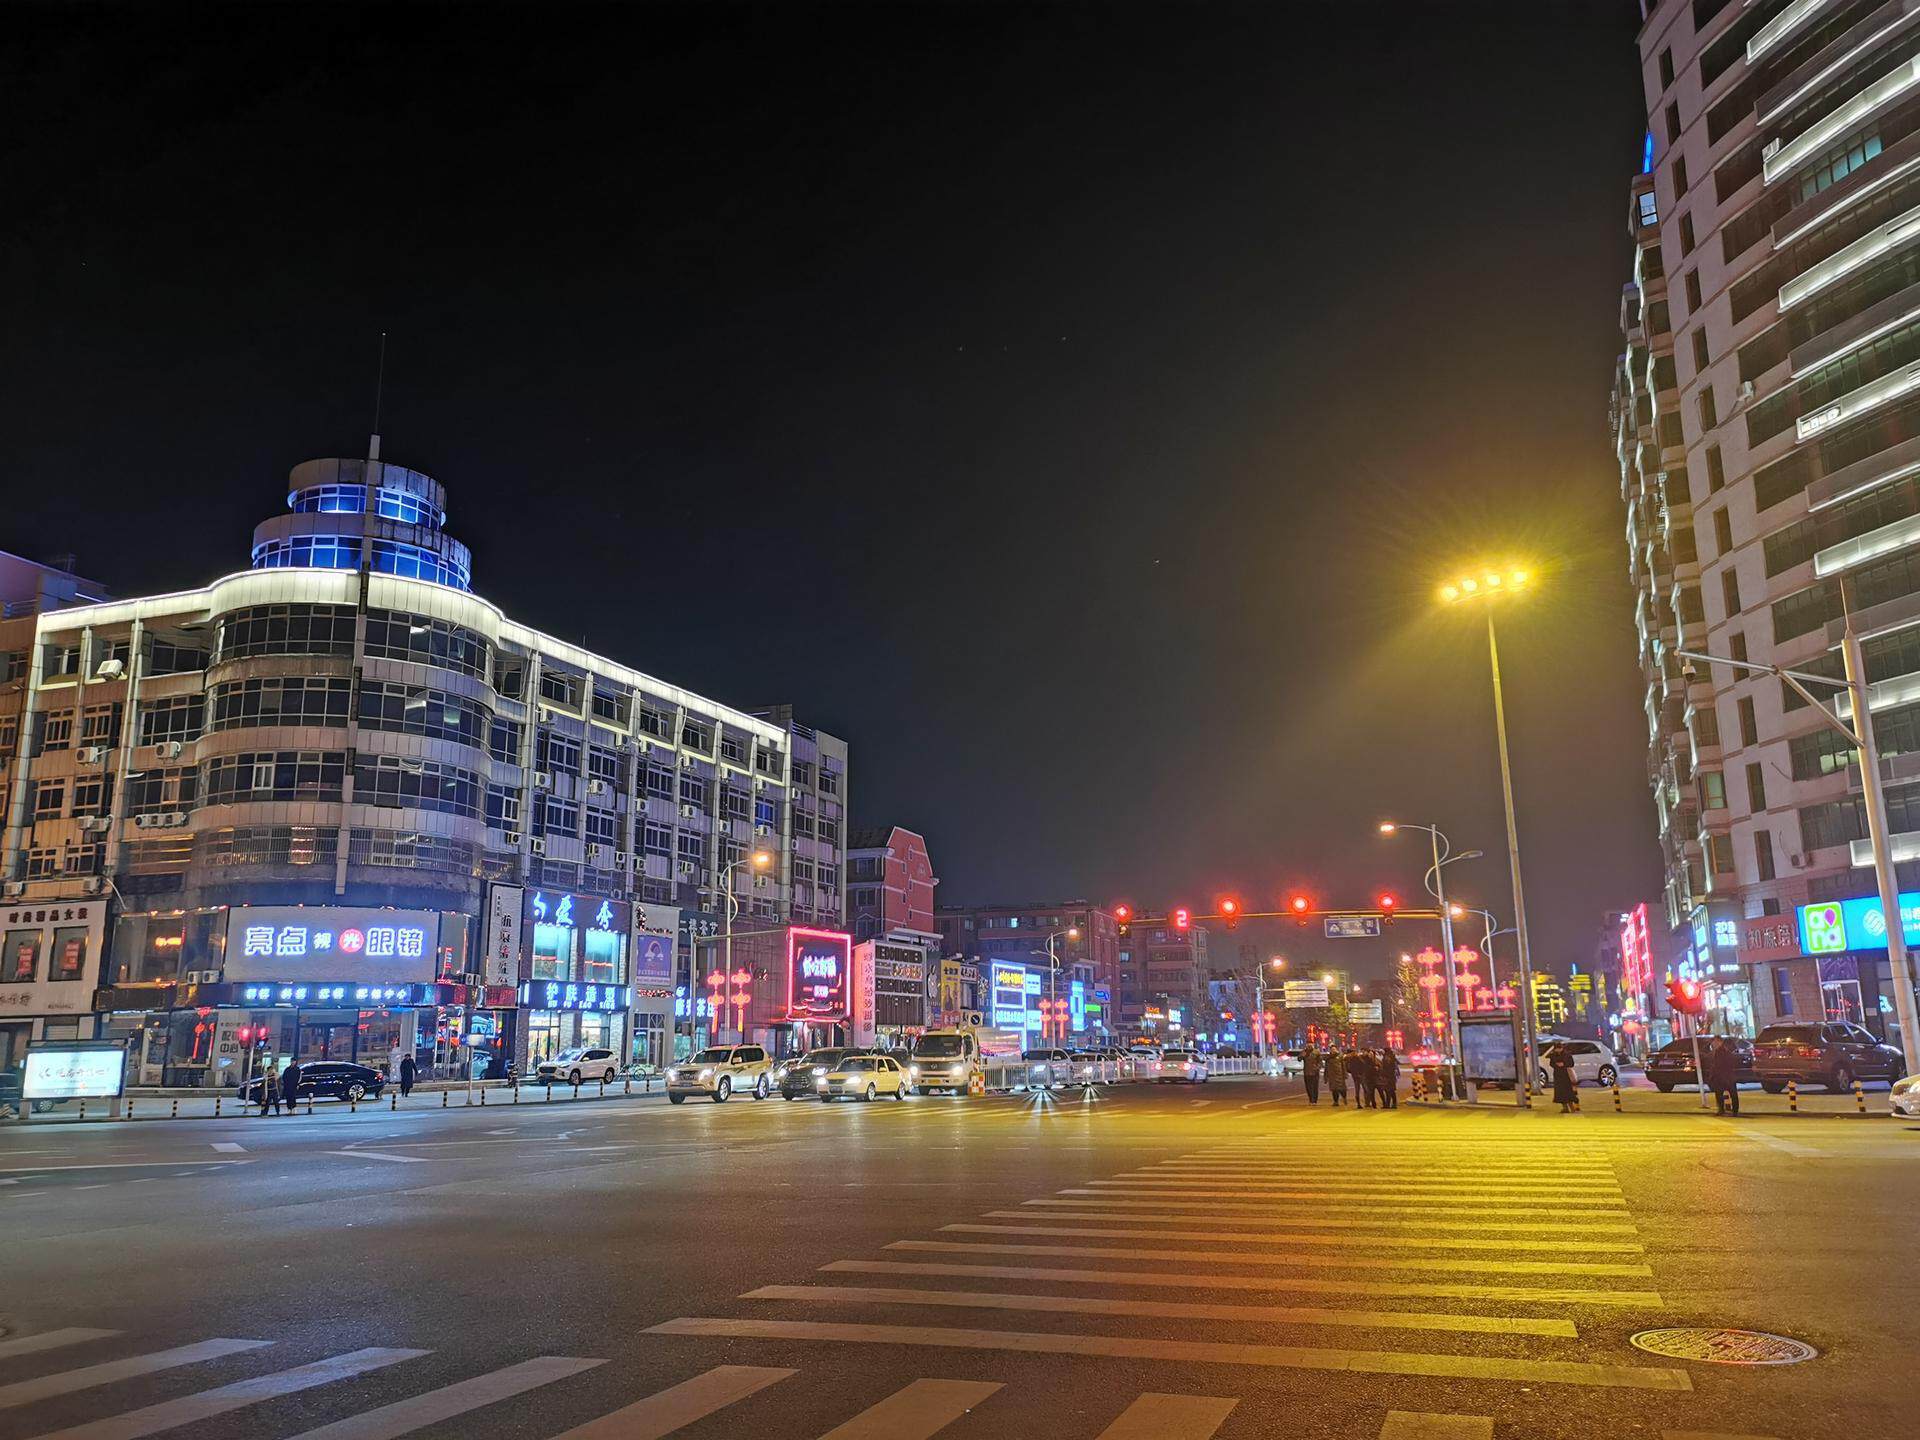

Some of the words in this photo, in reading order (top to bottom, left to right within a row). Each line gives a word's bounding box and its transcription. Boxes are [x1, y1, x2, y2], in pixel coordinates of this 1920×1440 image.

[1176, 909, 1187, 926] 2
[244, 926, 424, 957] 亮点视光眼镜
